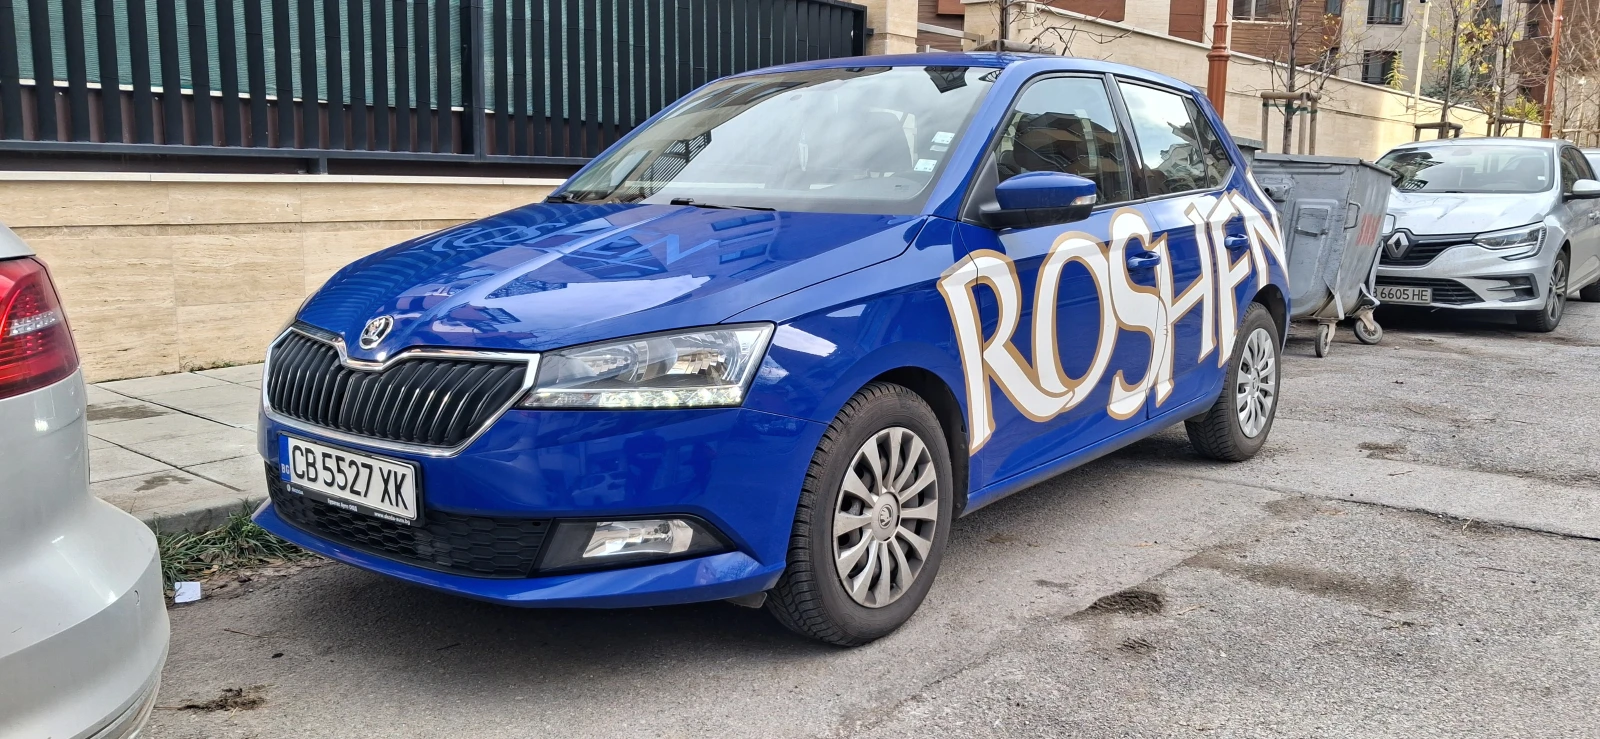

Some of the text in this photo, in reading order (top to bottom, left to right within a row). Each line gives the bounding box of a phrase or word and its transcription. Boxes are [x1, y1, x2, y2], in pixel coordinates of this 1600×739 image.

[937, 170, 1290, 456] ROSHEN
[1380, 287, 1410, 301] 6605
[1412, 289, 1429, 302] HE
[281, 444, 409, 511] BG CB 5527 XK
